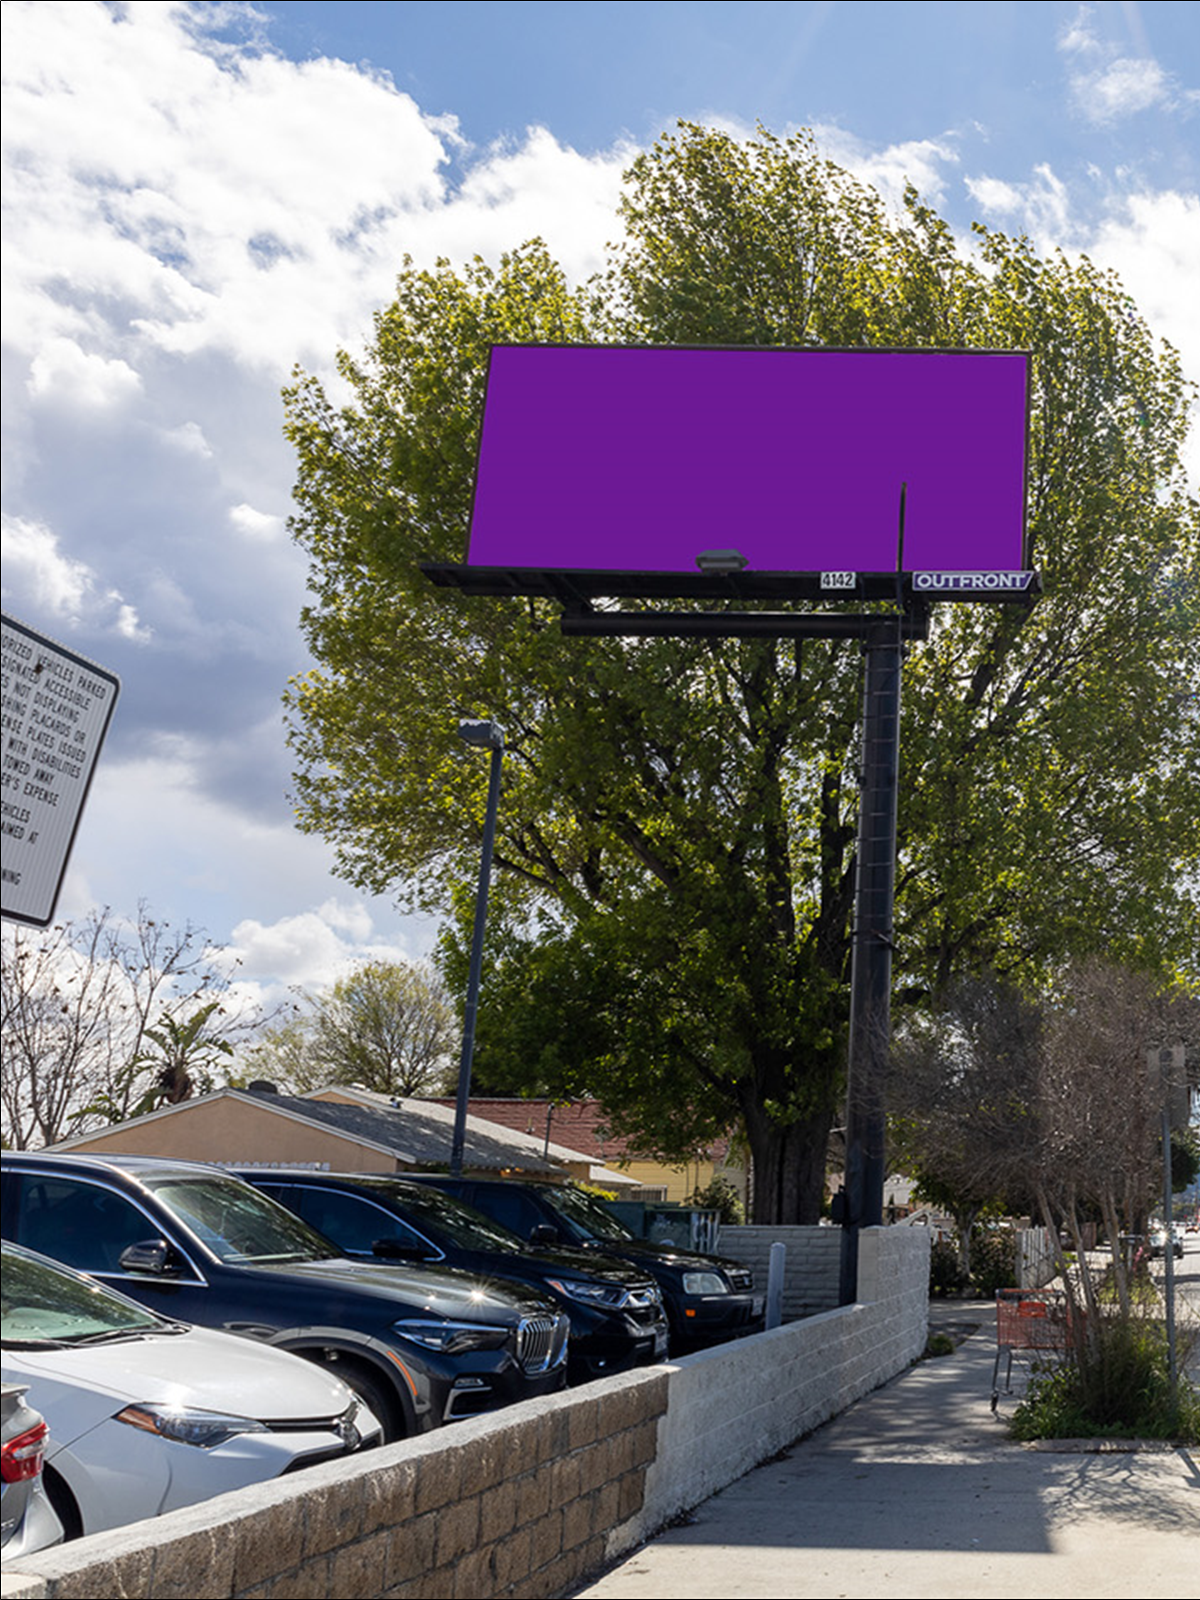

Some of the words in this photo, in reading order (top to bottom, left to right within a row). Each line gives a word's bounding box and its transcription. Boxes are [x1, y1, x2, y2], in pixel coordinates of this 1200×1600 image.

[822, 572, 854, 588] 4142
[917, 574, 1027, 589] OUTFRONT
[1, 634, 32, 660] ORIZED
[37, 653, 74, 683] VEHICLES
[77, 675, 106, 700] PARKED
[1, 652, 41, 684] SIGNATED
[43, 678, 91, 711] ACCESSIBLE
[13, 681, 31, 699] NOT
[33, 691, 80, 723] DISPLAYING
[30, 709, 72, 738] PLACARDS
[74, 730, 86, 744] OR
[8, 736, 28, 756] WITH
[31, 748, 81, 779] DISABILITIES
[26, 726, 55, 749] PLATES
[58, 741, 86, 763] ISSUED
[2, 754, 31, 776] TOWED
[33, 768, 54, 785] AWAY
[23, 782, 59, 807] EXPENSE
[27, 831, 39, 844] AT
